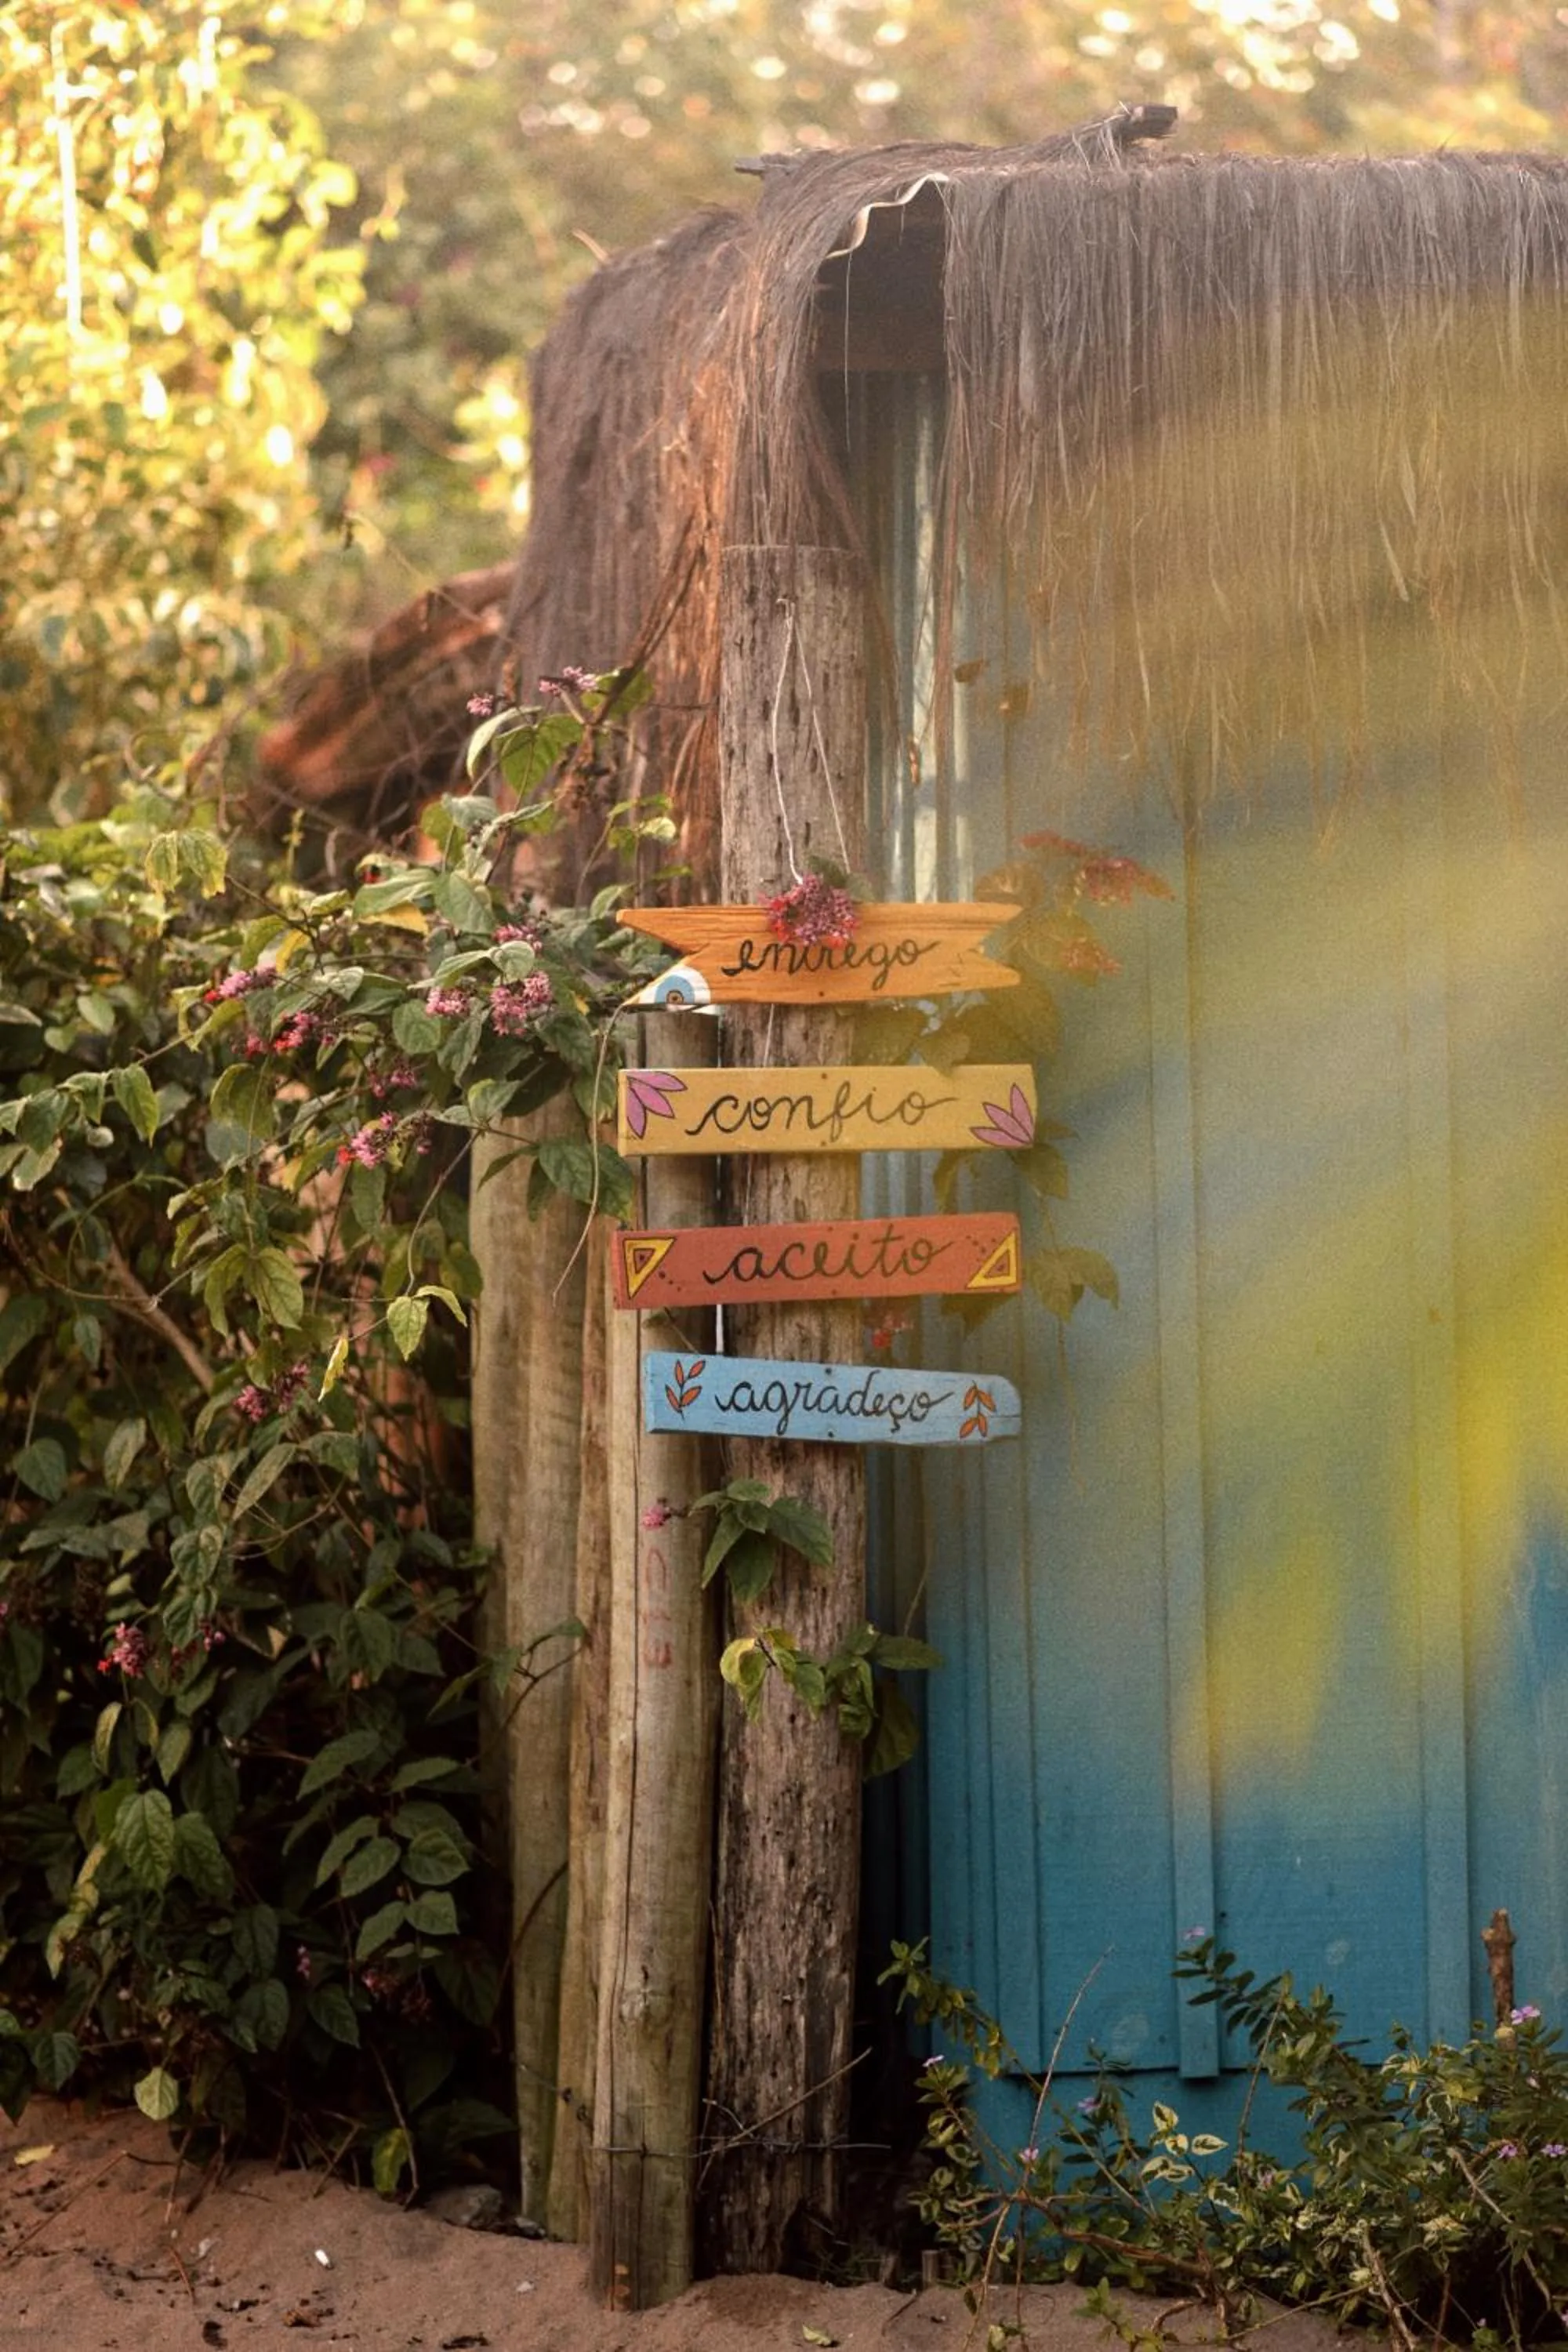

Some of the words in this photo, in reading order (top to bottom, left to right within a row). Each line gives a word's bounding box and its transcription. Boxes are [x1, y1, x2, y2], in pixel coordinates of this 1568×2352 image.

[684, 1080, 958, 1142] confio
[702, 1223, 954, 1284] aceito
[715, 1370, 954, 1436] agradeço
